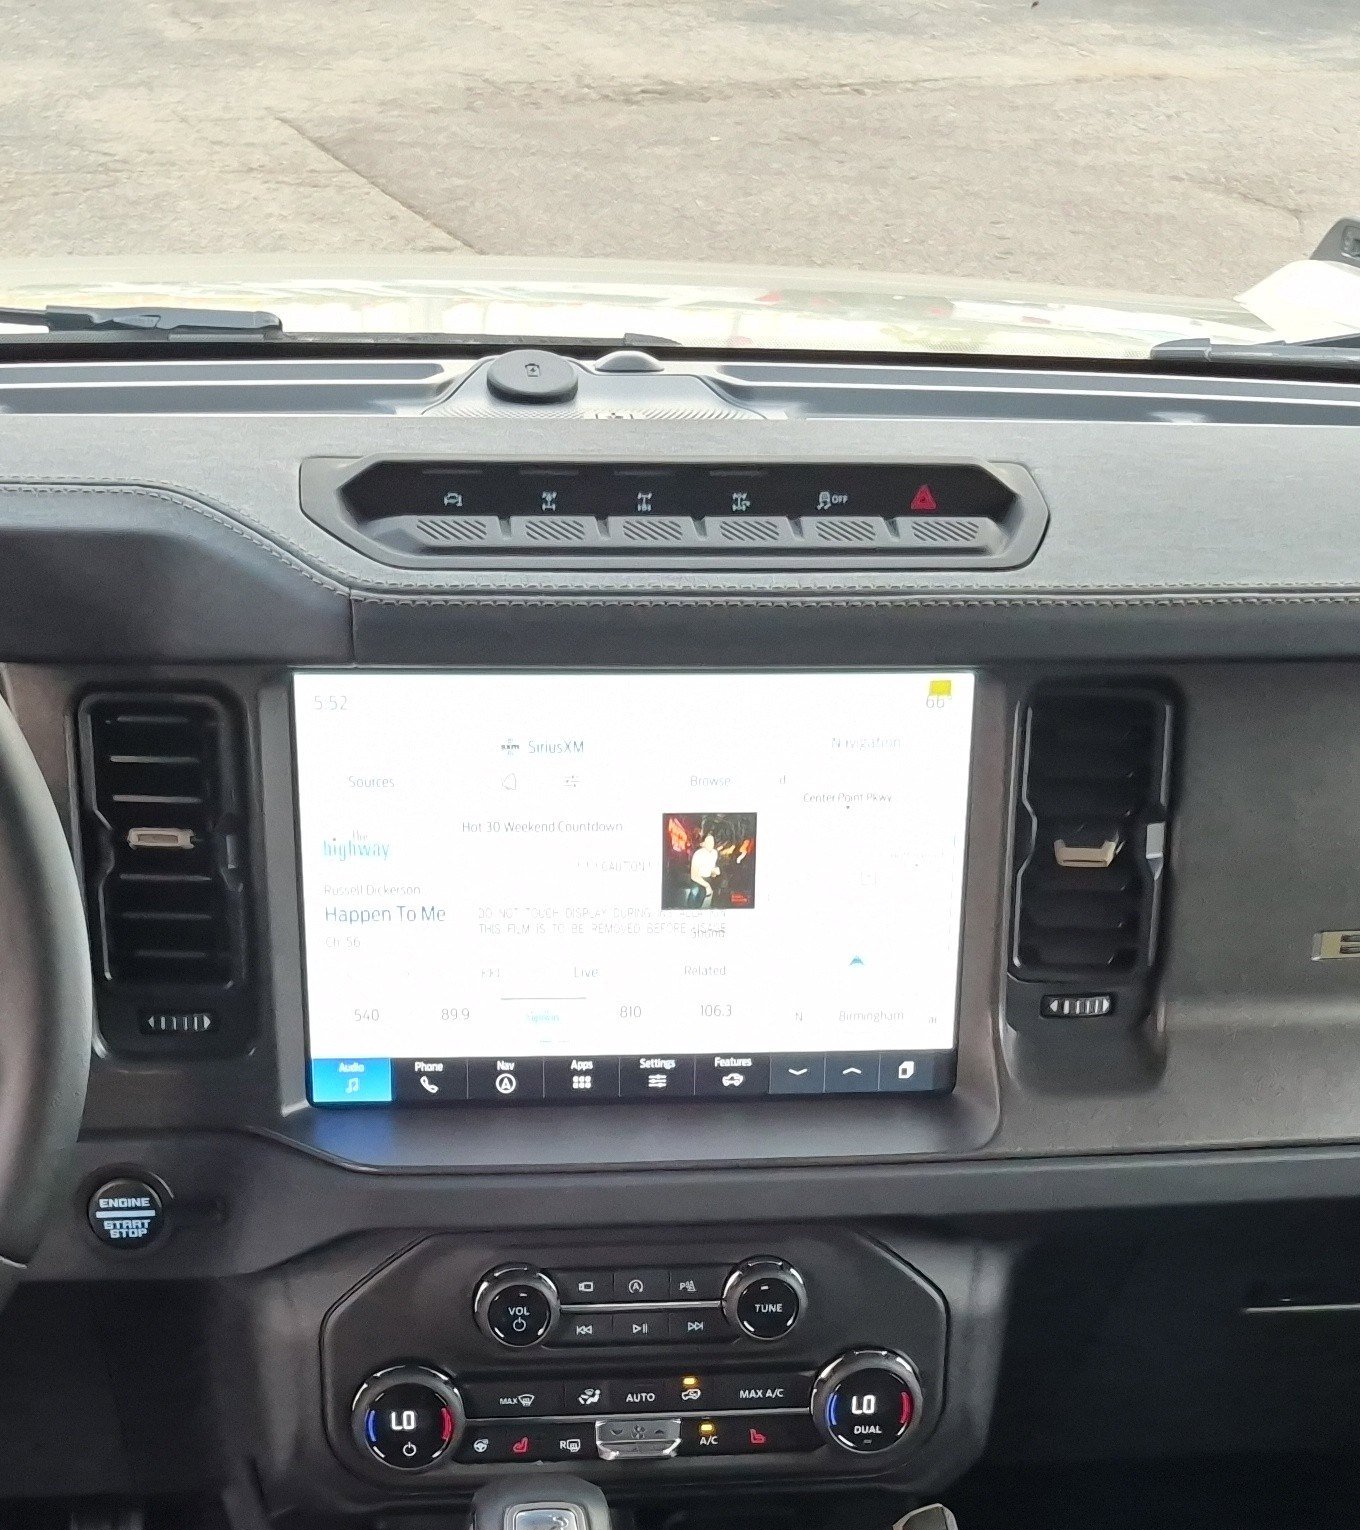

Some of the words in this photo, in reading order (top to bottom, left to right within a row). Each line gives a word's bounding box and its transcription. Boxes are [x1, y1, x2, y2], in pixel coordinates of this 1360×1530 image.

[527, 739, 584, 754] SiriusXM
[348, 775, 395, 788] Sources
[690, 775, 731, 787] Browse
[462, 822, 482, 833] Hot
[486, 822, 500, 833] 30
[504, 822, 555, 833] Weekend
[557, 821, 623, 833] Countdown
[323, 837, 390, 861] highway
[325, 906, 392, 924] Happen
[396, 906, 417, 922] To
[422, 905, 446, 922] Me
[574, 967, 599, 978] Live
[683, 965, 727, 977] Related
[354, 1009, 380, 1022] 540
[700, 1004, 732, 1018] 106.3
[839, 1010, 904, 1023] Birmingham
[338, 1062, 364, 1073] Audio
[414, 1061, 443, 1073] Phone
[497, 1061, 515, 1072] Nav
[570, 1059, 593, 1071] Apps
[640, 1058, 676, 1070] Settings
[714, 1057, 752, 1067] Features
[99, 1198, 150, 1208] ENGINE
[104, 1220, 151, 1229] START
[110, 1229, 148, 1238] STOP
[508, 1306, 530, 1316] VOL
[755, 1304, 783, 1312] TUNE
[626, 1393, 655, 1402] AUTO
[740, 1389, 763, 1398] MAX
[766, 1388, 784, 1398] A/C
[500, 1397, 518, 1405] MAX
[851, 1395, 876, 1414] LO
[391, 1410, 416, 1430] LO
[854, 1425, 881, 1434] DUAL
[700, 1436, 718, 1445] A/C
